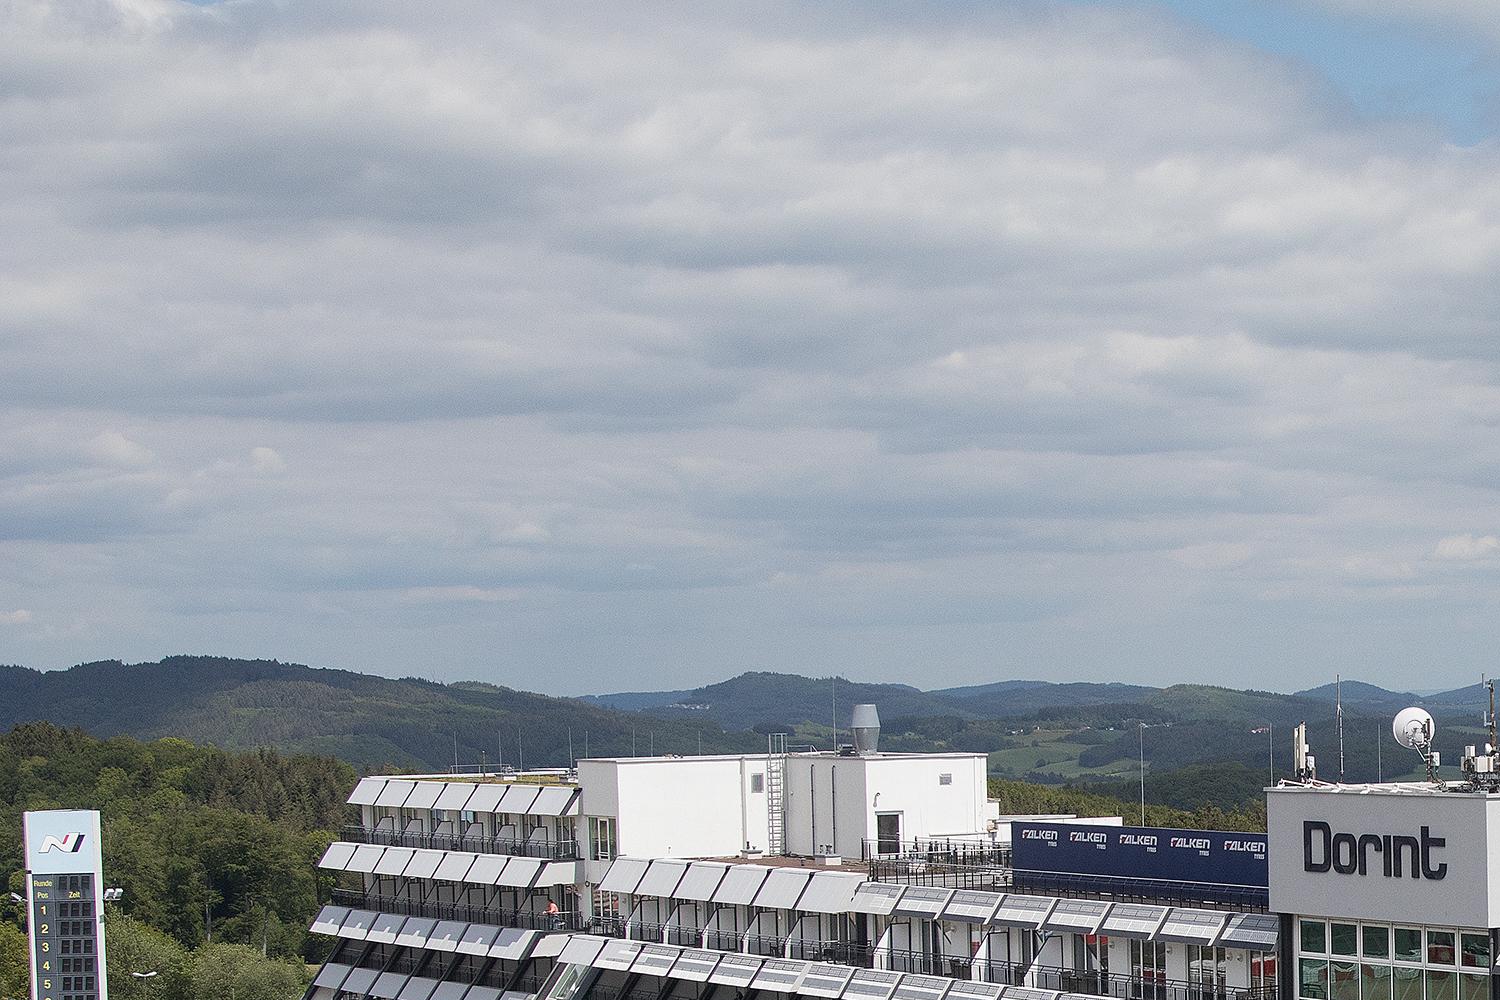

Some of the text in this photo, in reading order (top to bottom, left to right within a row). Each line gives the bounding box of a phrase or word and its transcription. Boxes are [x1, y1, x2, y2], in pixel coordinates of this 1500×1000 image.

[1022, 829, 1058, 840] FALKEN
[1069, 831, 1107, 843] FALKEN
[1119, 834, 1158, 846] FALKEN
[1170, 837, 1211, 849] FALKEN
[1224, 840, 1266, 853] FALKEN
[1303, 820, 1448, 880] Dorint
[33, 880, 53, 888] Runde
[37, 891, 81, 899] Pos Zeit
[40, 905, 47, 915] 1
[41, 924, 49, 934] 2
[42, 942, 50, 952] 3
[43, 961, 50, 971] 4
[43, 979, 51, 989] 5
